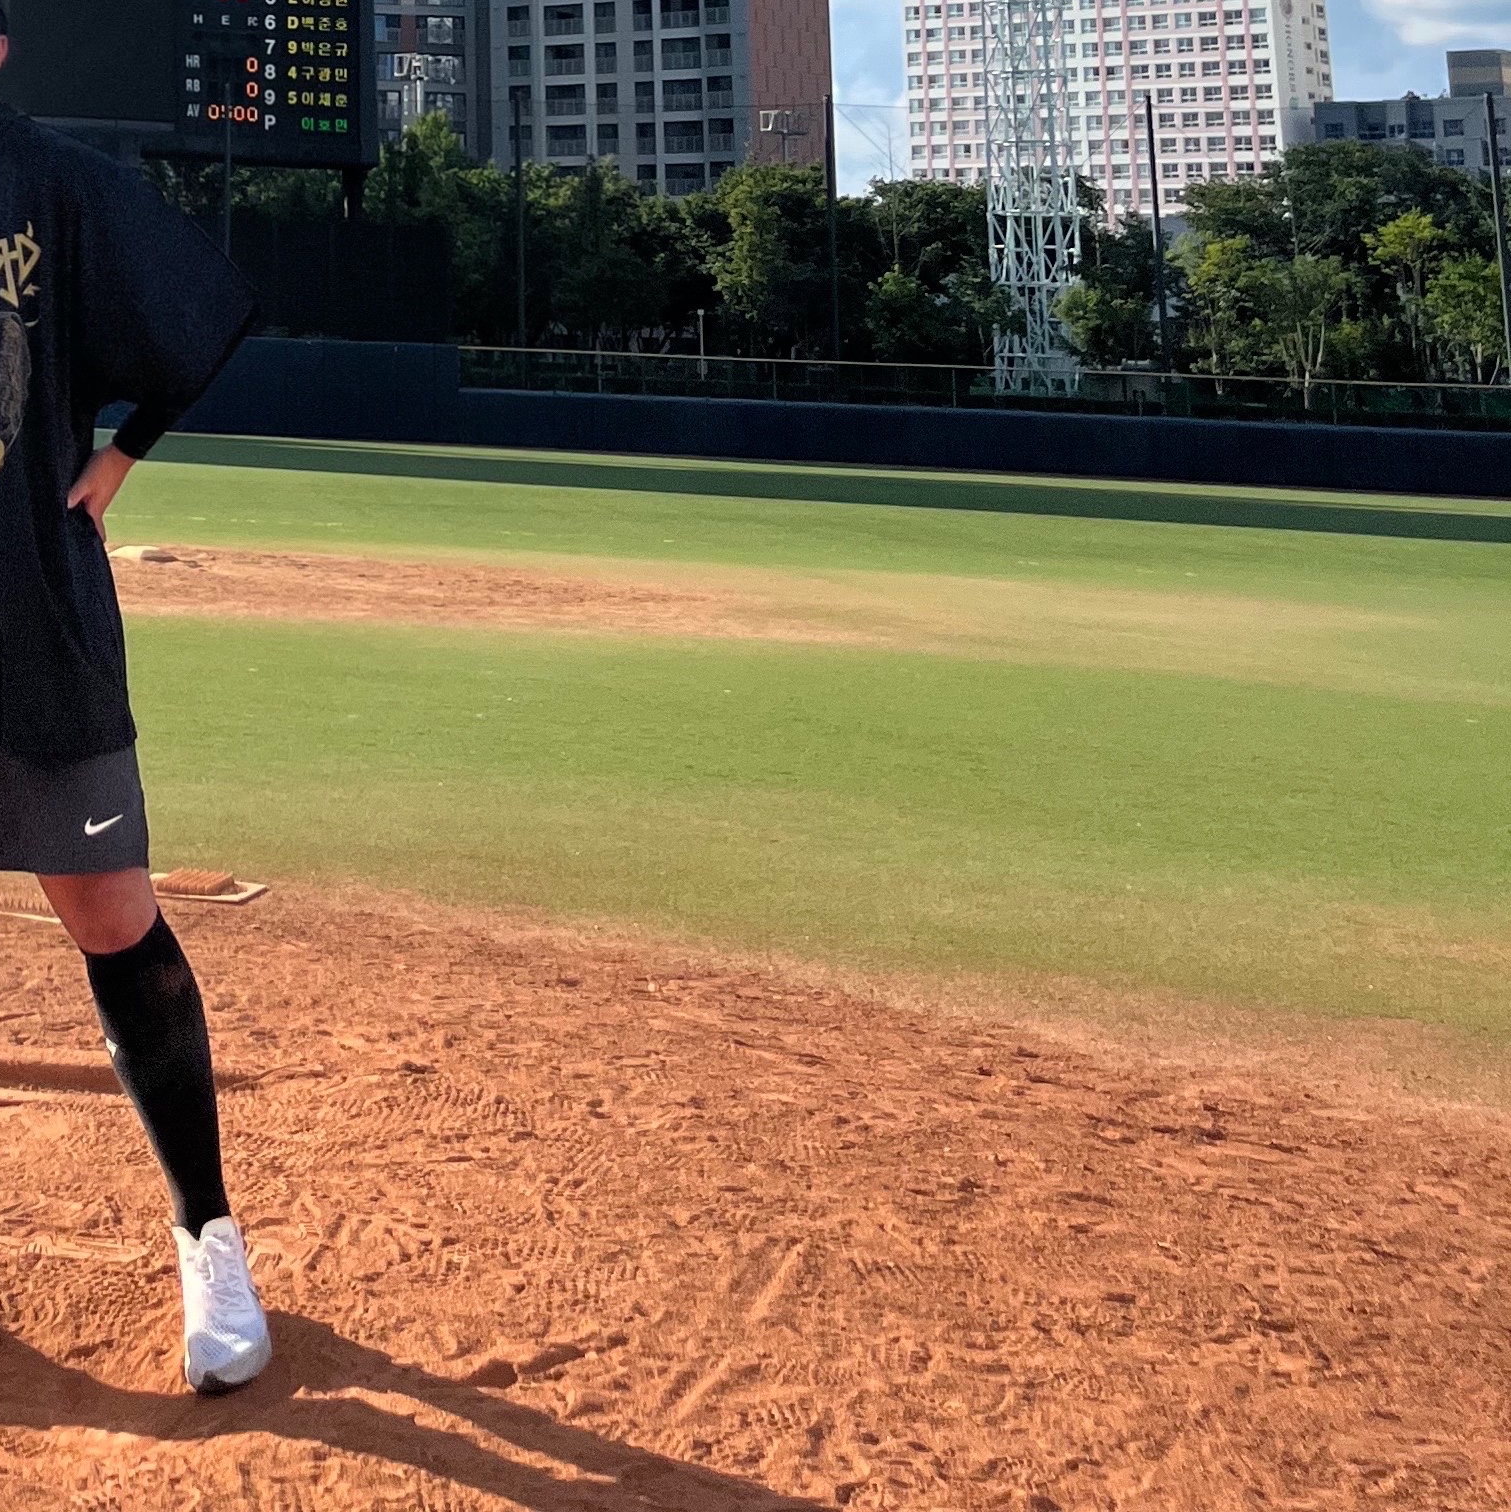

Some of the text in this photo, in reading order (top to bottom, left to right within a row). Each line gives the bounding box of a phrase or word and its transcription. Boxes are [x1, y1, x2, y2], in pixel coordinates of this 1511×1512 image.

[265, 15, 275, 29] 6
[265, 39, 275, 54] 7
[186, 55, 257, 72] HR 0
[265, 64, 275, 79] 8
[247, 82, 258, 97] 0
[265, 90, 275, 105] 9
[265, 115, 275, 130] P
